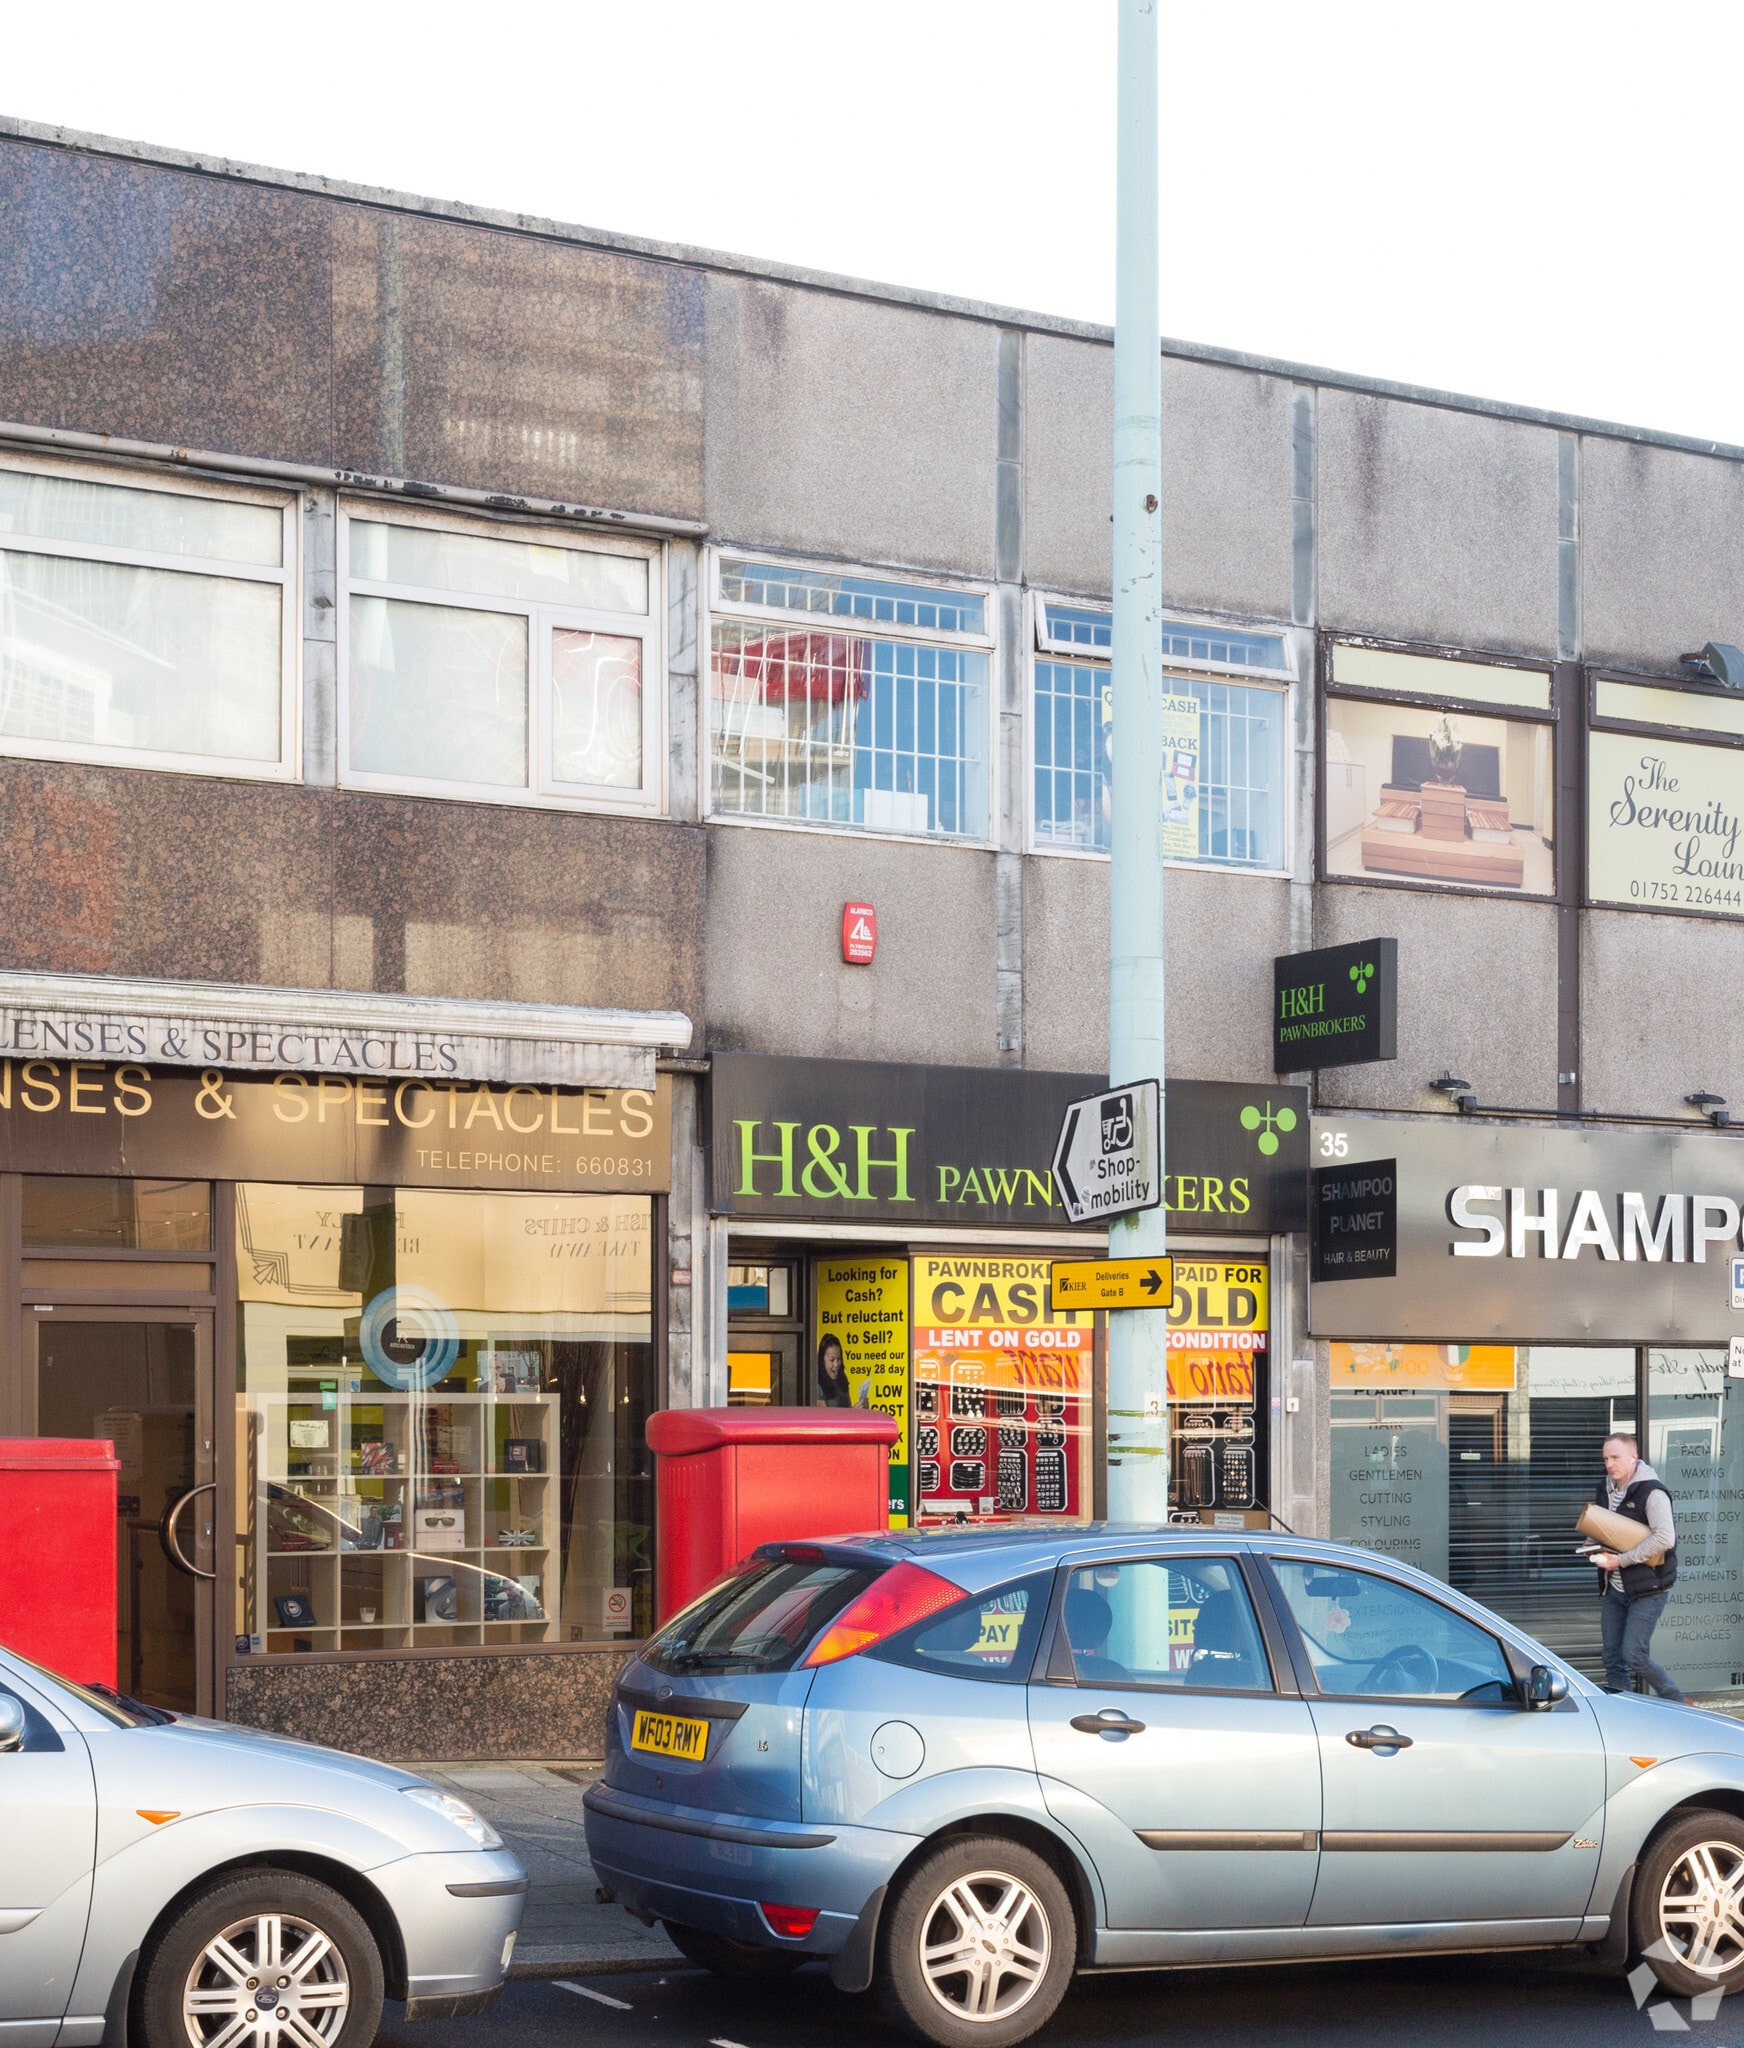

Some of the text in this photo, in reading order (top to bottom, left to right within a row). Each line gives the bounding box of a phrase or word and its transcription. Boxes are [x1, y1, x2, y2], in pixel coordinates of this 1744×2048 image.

[1638, 756, 1681, 792] The
[1609, 775, 1742, 859] Serenity
[1630, 880, 1742, 907] 01752 226444
[1280, 983, 1325, 1019] H&H
[1280, 1014, 1366, 1042] PAWNBROKERS
[161, 1027, 190, 1059] &
[203, 1029, 458, 1072] SPECTACLES
[194, 1068, 237, 1120] &
[272, 1072, 654, 1138] SPECTACLES
[1320, 1131, 1348, 1158] 35
[416, 1149, 652, 1177] TELEPHONE: 660831
[732, 1119, 916, 1201] H&H
[1097, 1155, 1141, 1179] Shop-
[1090, 1180, 1150, 1209] mobility
[1322, 1176, 1392, 1201] SHAMPOO
[1330, 1211, 1384, 1234] PLANET
[1450, 1185, 1744, 1263] SHAMP
[1324, 1247, 1390, 1264] HAIR & BEAUTY
[828, 1266, 897, 1283] Looking for
[1095, 1271, 1129, 1281] Deliveries
[1175, 1266, 1218, 1282] PAID
[1224, 1267, 1262, 1283] FOR
[1068, 1281, 1087, 1291] KIER
[1101, 1287, 1124, 1297] Gate B
[845, 1288, 883, 1302] Cash?
[1166, 1285, 1258, 1326] OLD
[822, 1309, 904, 1324] But reluctant
[847, 1330, 893, 1344] to Sell?
[928, 1329, 1081, 1348] LENT ON GOLD
[845, 1350, 905, 1360] You need our
[850, 1364, 905, 1376] easy 28 day
[875, 1385, 903, 1398] LOW
[1681, 1445, 1726, 1457] FACIAS
[1349, 1469, 1422, 1481] GENTLEMEN
[1681, 1467, 1725, 1479] WAXING
[1359, 1492, 1412, 1504] CUTTING
[1699, 1489, 1744, 1501] TANNING
[1360, 1515, 1411, 1527] STYLING
[1674, 1511, 1740, 1523] EFLEXOLOGY
[1350, 1538, 1421, 1550] COLOURING
[1678, 1533, 1728, 1544] MASSAGE
[1685, 1555, 1720, 1567] BOTOX
[1676, 1569, 1737, 1582] REATMENTS
[1675, 1629, 1731, 1641] PACKAGES
[638, 1715, 702, 1754] WF03 RMY
